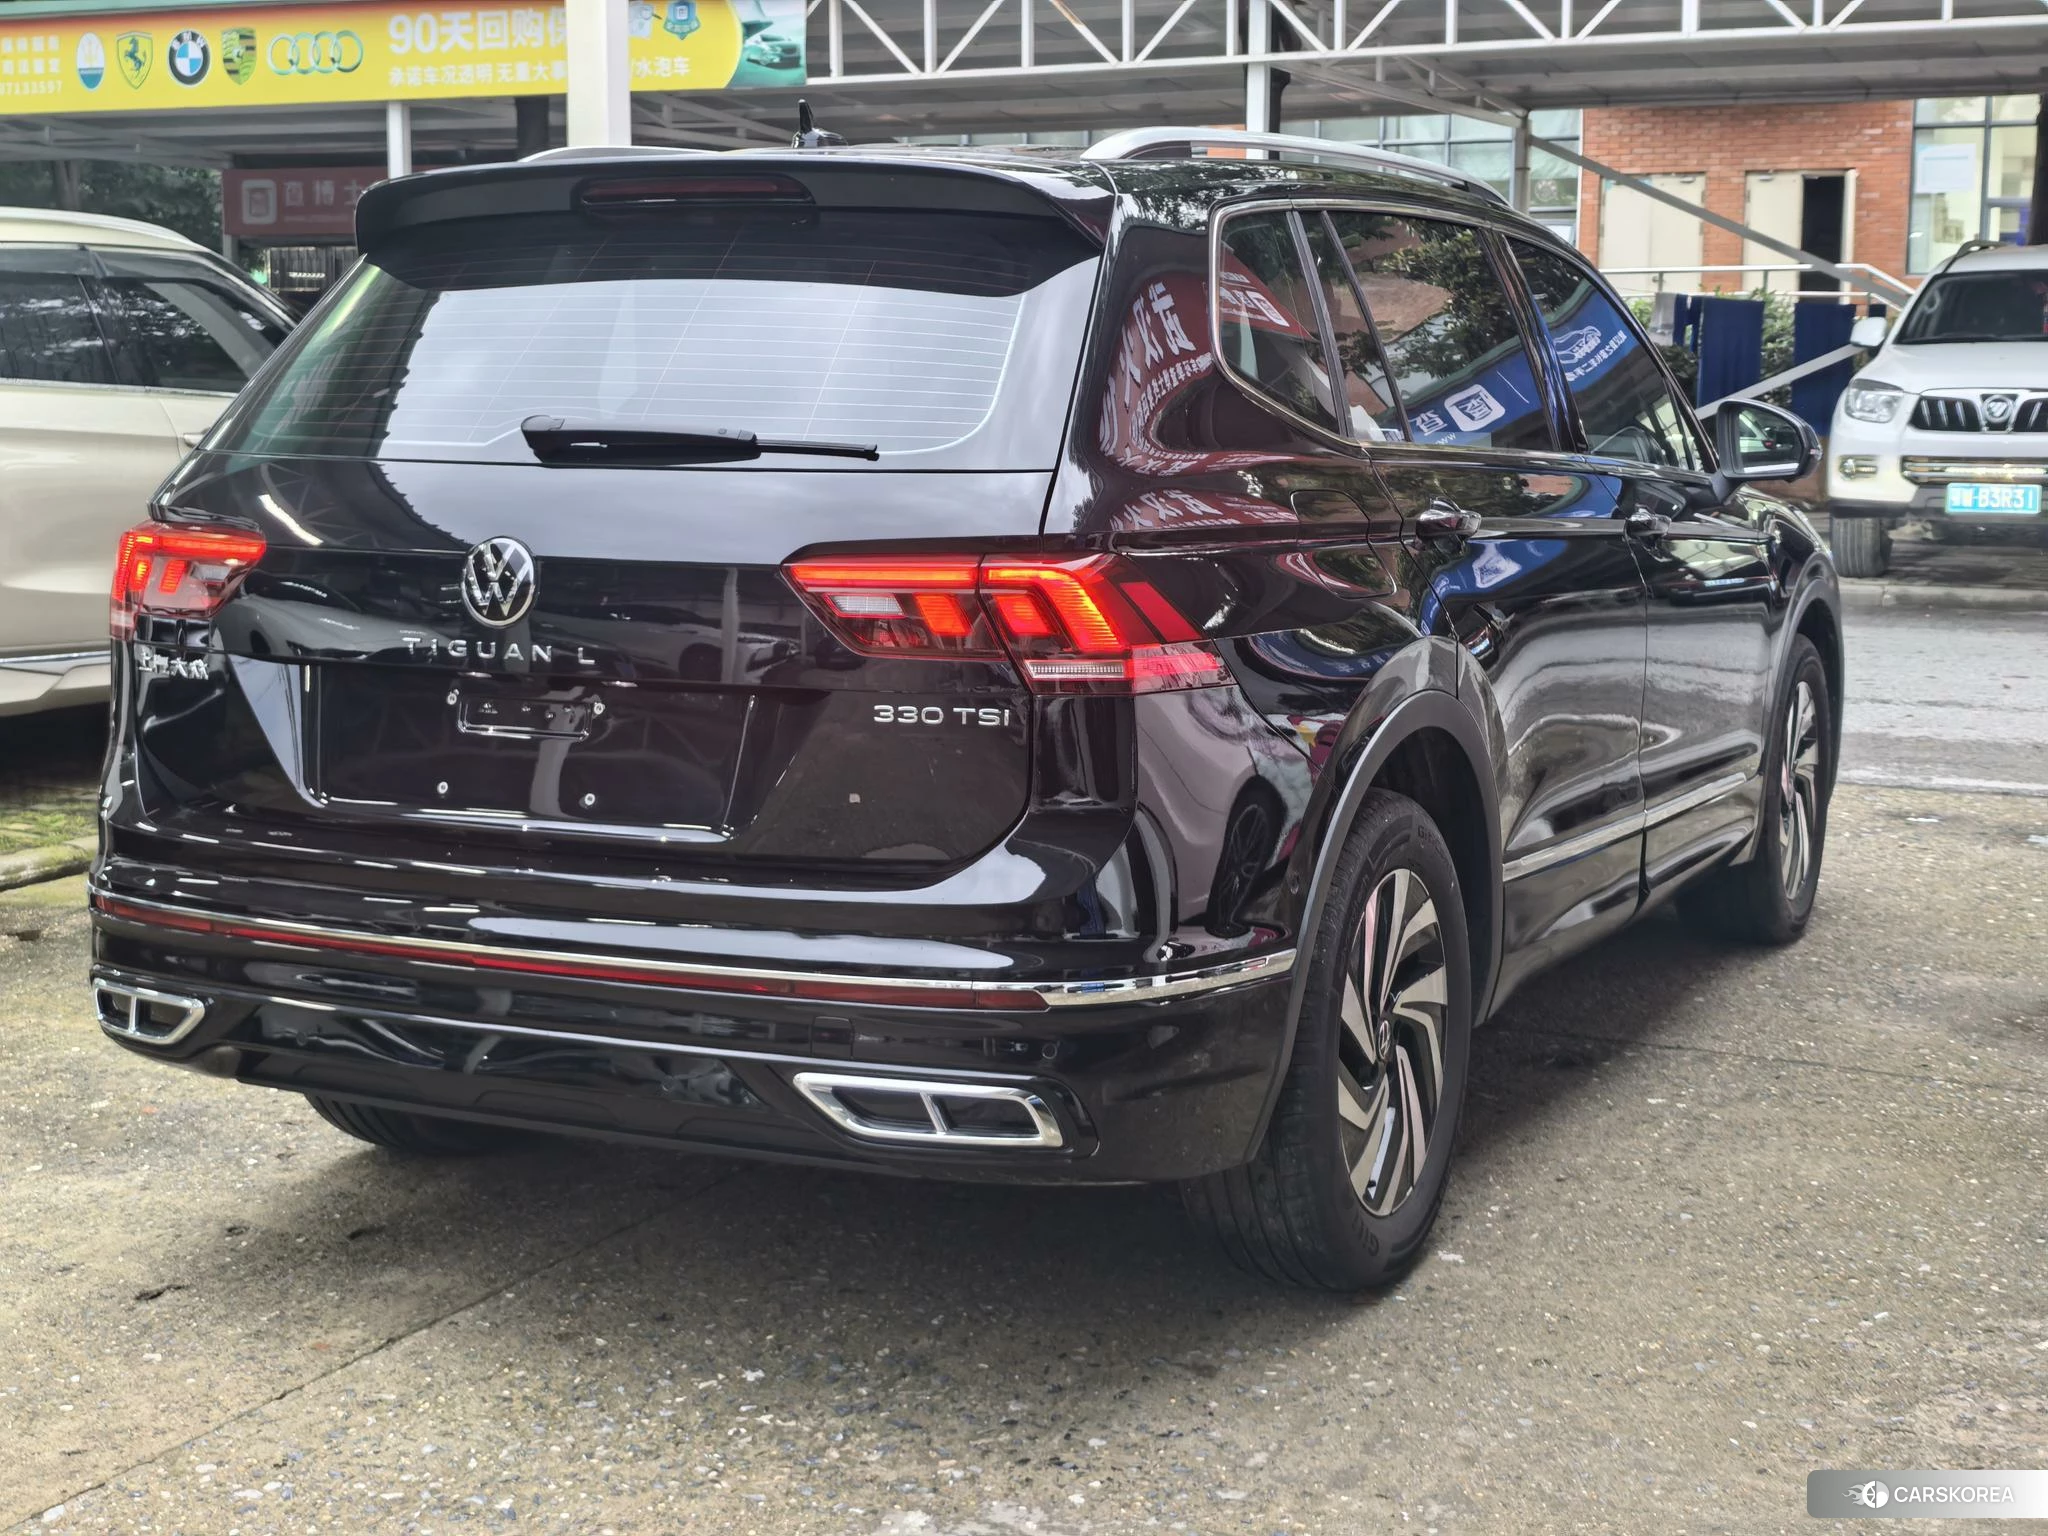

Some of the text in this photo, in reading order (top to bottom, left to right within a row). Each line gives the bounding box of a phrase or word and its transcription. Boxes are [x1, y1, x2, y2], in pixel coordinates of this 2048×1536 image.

[402, 637, 595, 665] TIGUAN L
[873, 705, 1010, 726] 330 TSI
